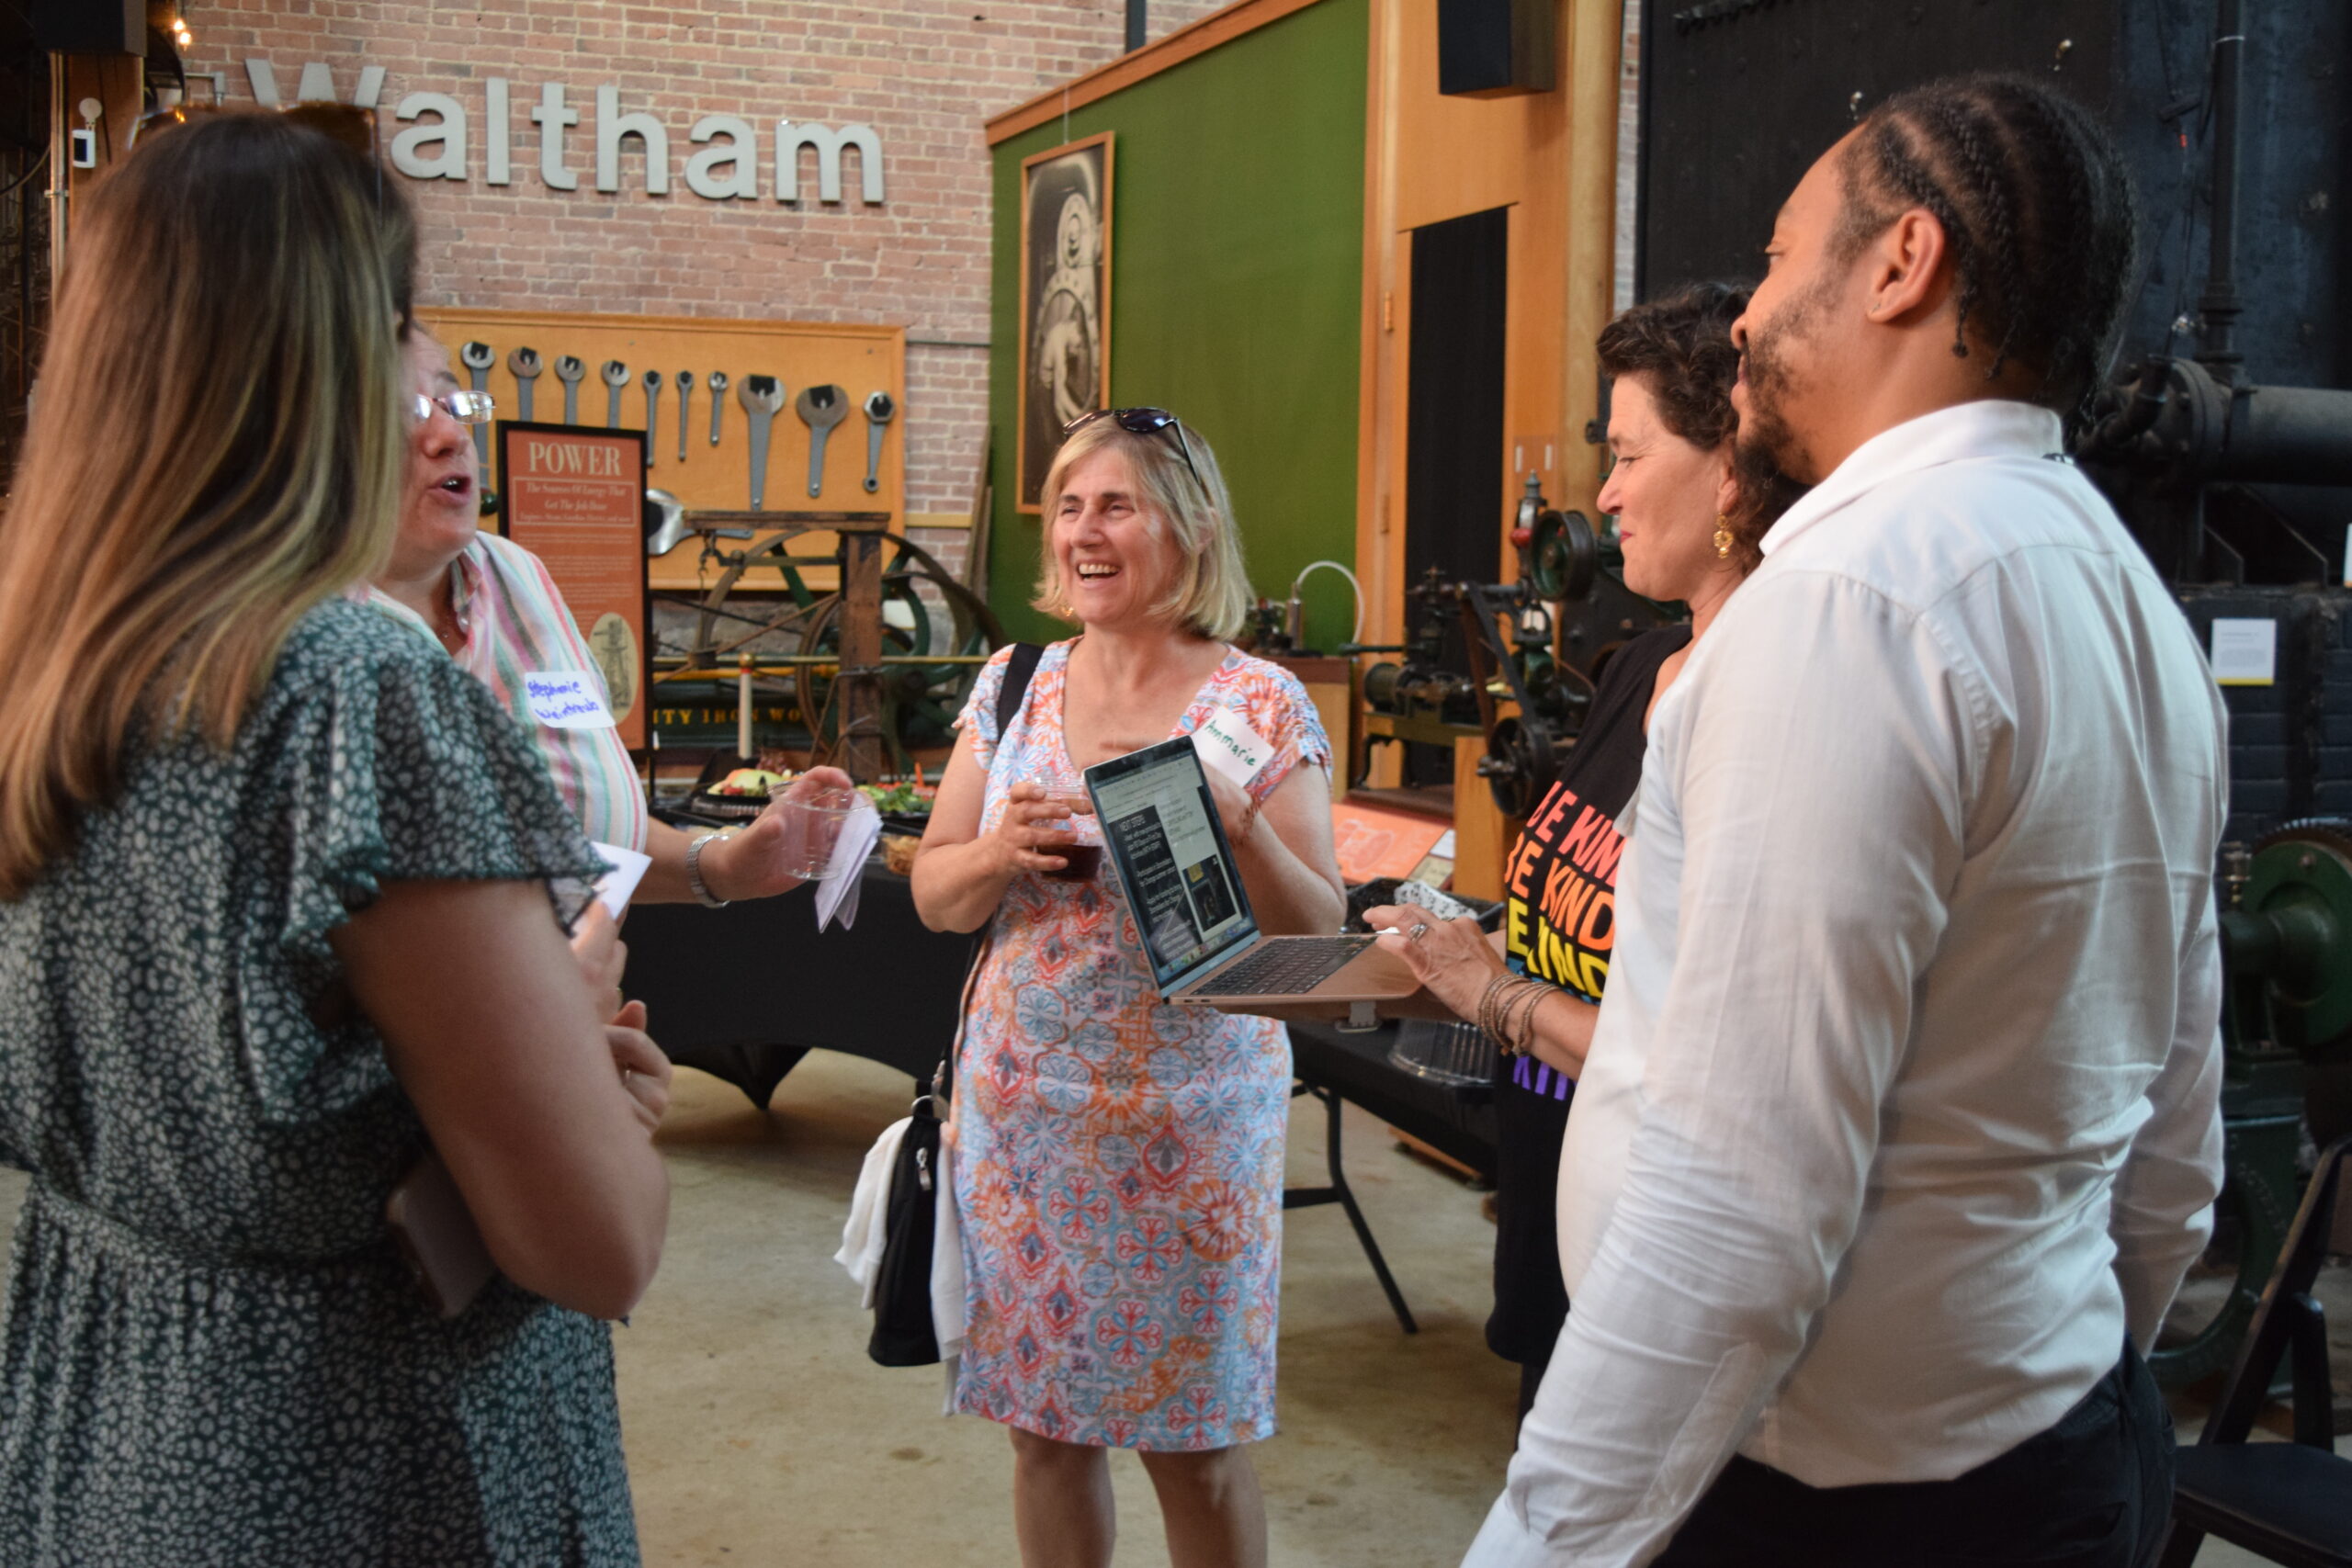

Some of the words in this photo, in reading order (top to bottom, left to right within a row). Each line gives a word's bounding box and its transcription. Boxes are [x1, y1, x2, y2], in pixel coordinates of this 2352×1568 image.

[529, 442, 622, 476] POWER
[652, 708, 693, 725] ITY
[1508, 897, 1529, 956] E
[1539, 857, 1615, 951] KIND
